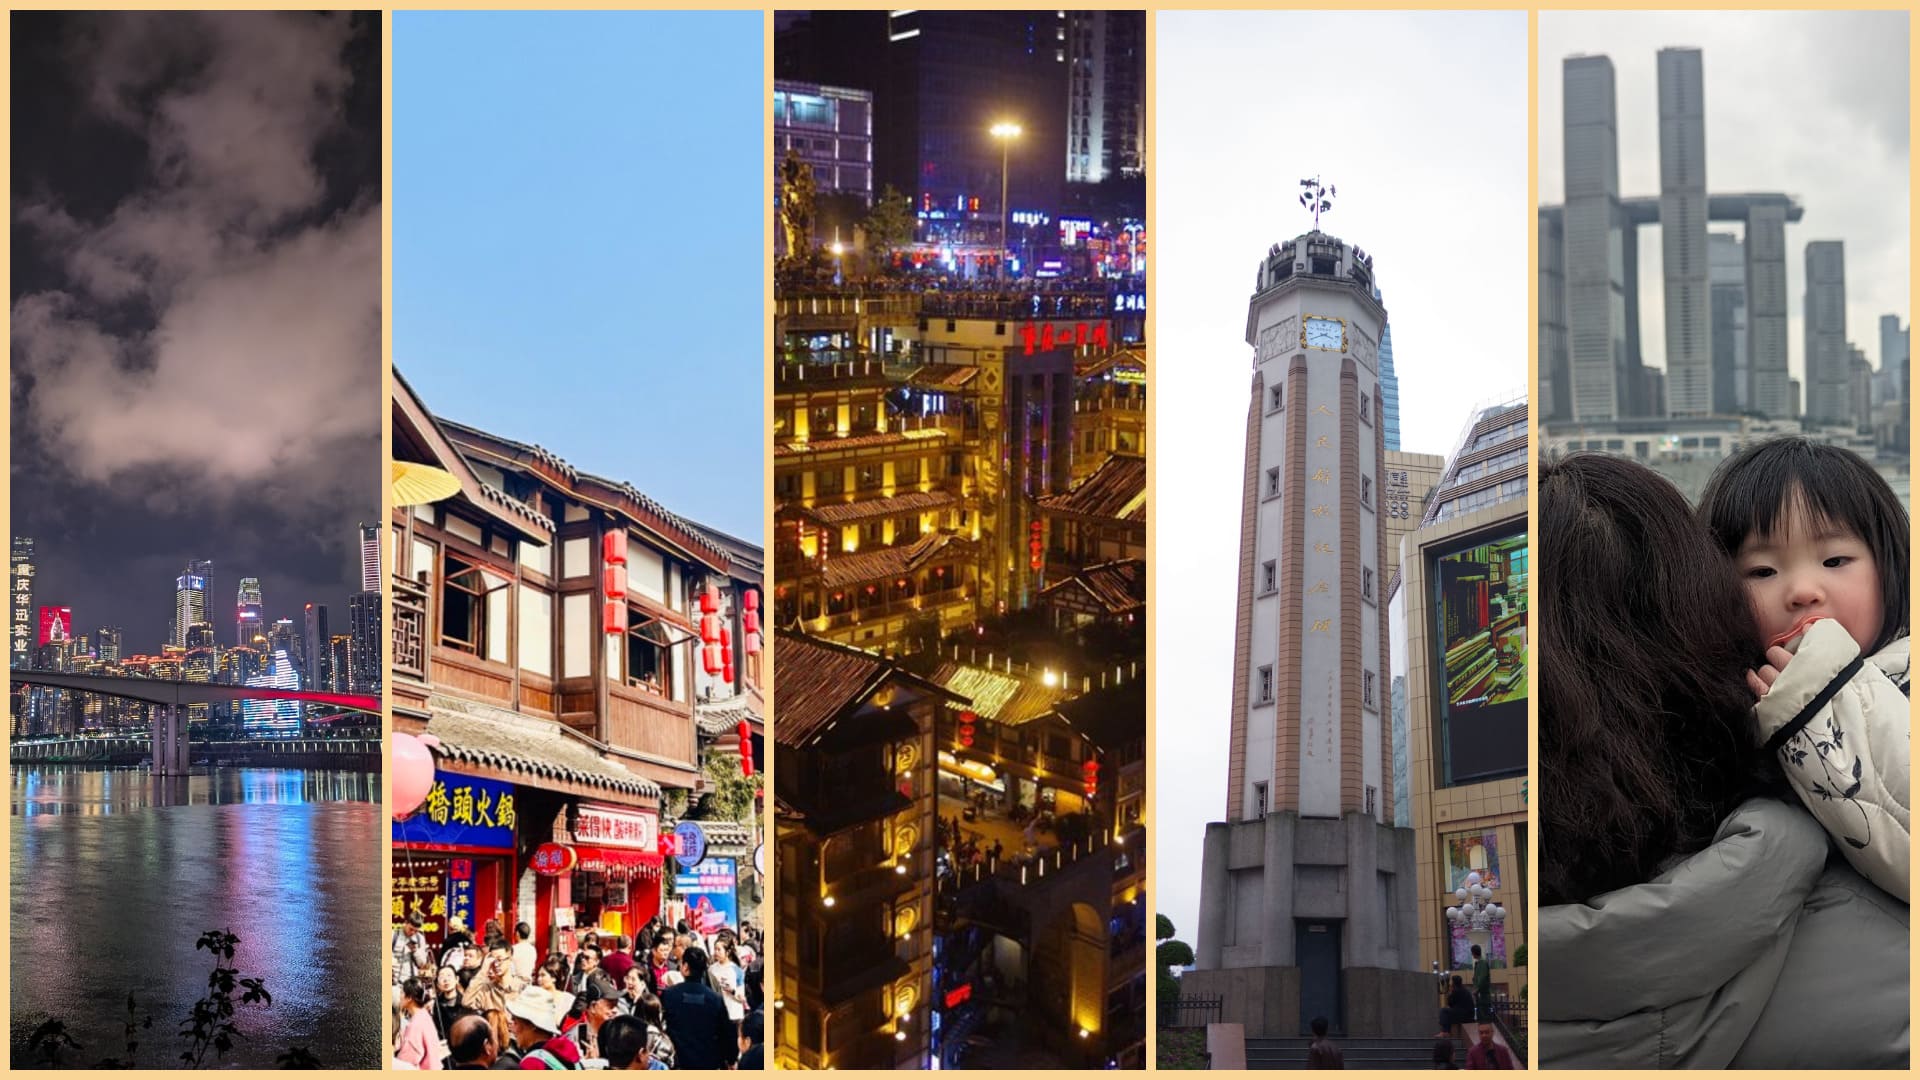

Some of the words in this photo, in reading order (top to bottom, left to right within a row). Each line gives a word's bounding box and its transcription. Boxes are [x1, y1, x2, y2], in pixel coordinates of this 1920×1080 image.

[14, 563, 30, 652] 重庆华迅实业
[426, 780, 516, 831] 橋頭火鍋
